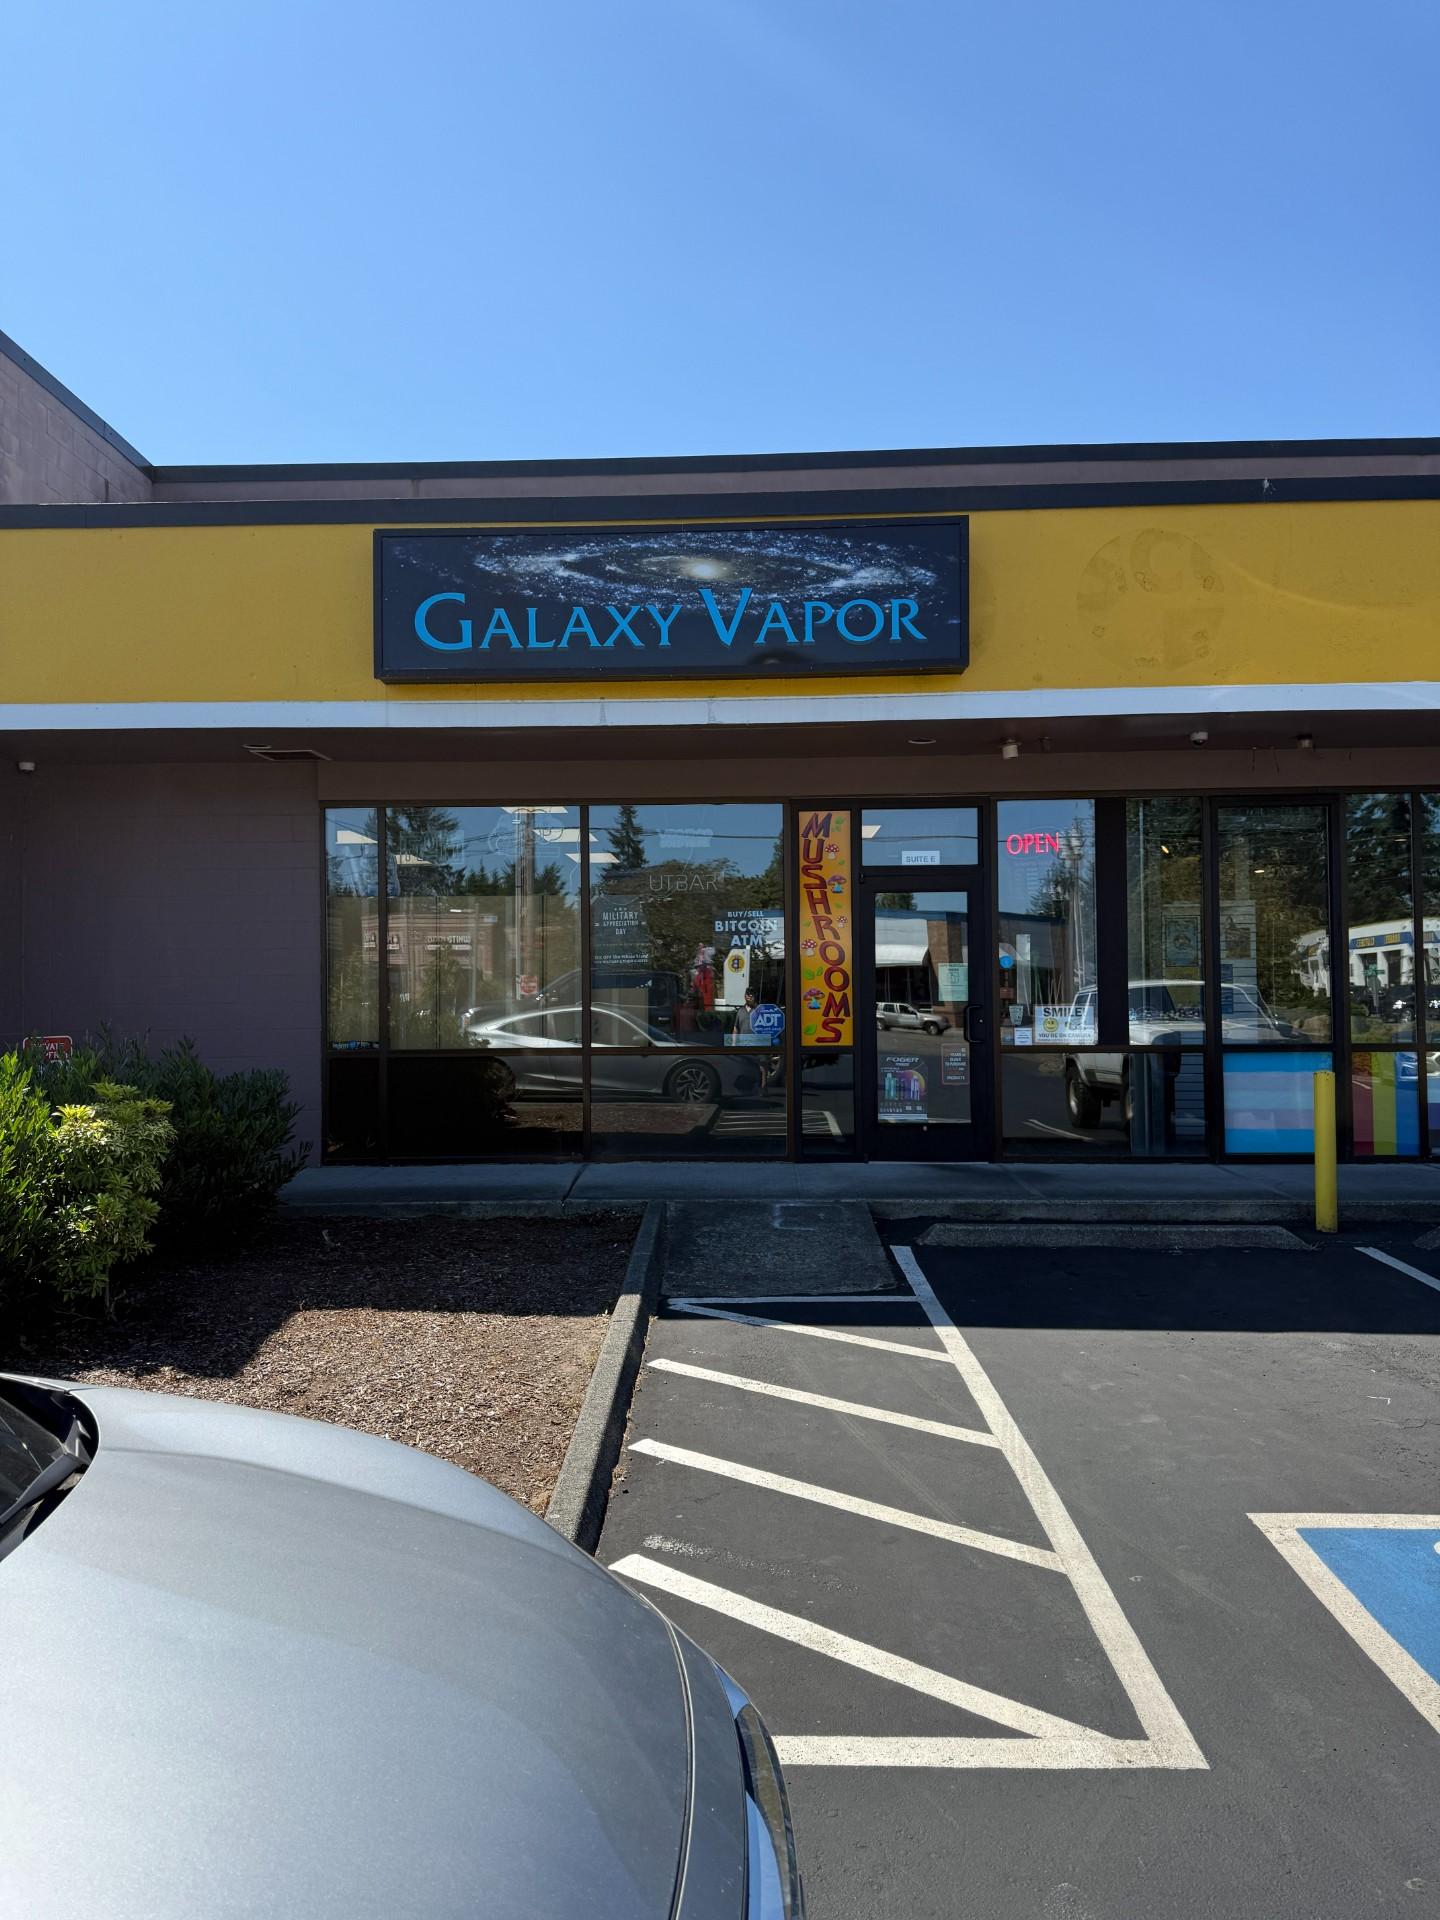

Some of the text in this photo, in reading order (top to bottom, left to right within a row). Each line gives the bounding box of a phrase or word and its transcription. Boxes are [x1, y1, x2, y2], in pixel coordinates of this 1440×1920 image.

[413, 587, 928, 651] GALAXY VAPOR
[1006, 832, 1060, 856] OPEN
[906, 855, 937, 863] SUITE E
[602, 911, 639, 921] MILITARY
[727, 910, 764, 918] BUY/SELL
[714, 919, 778, 932] BITCOIN
[801, 812, 851, 1044] MUSHROOMS
[730, 934, 763, 947] ATM
[753, 1013, 782, 1027] ADT
